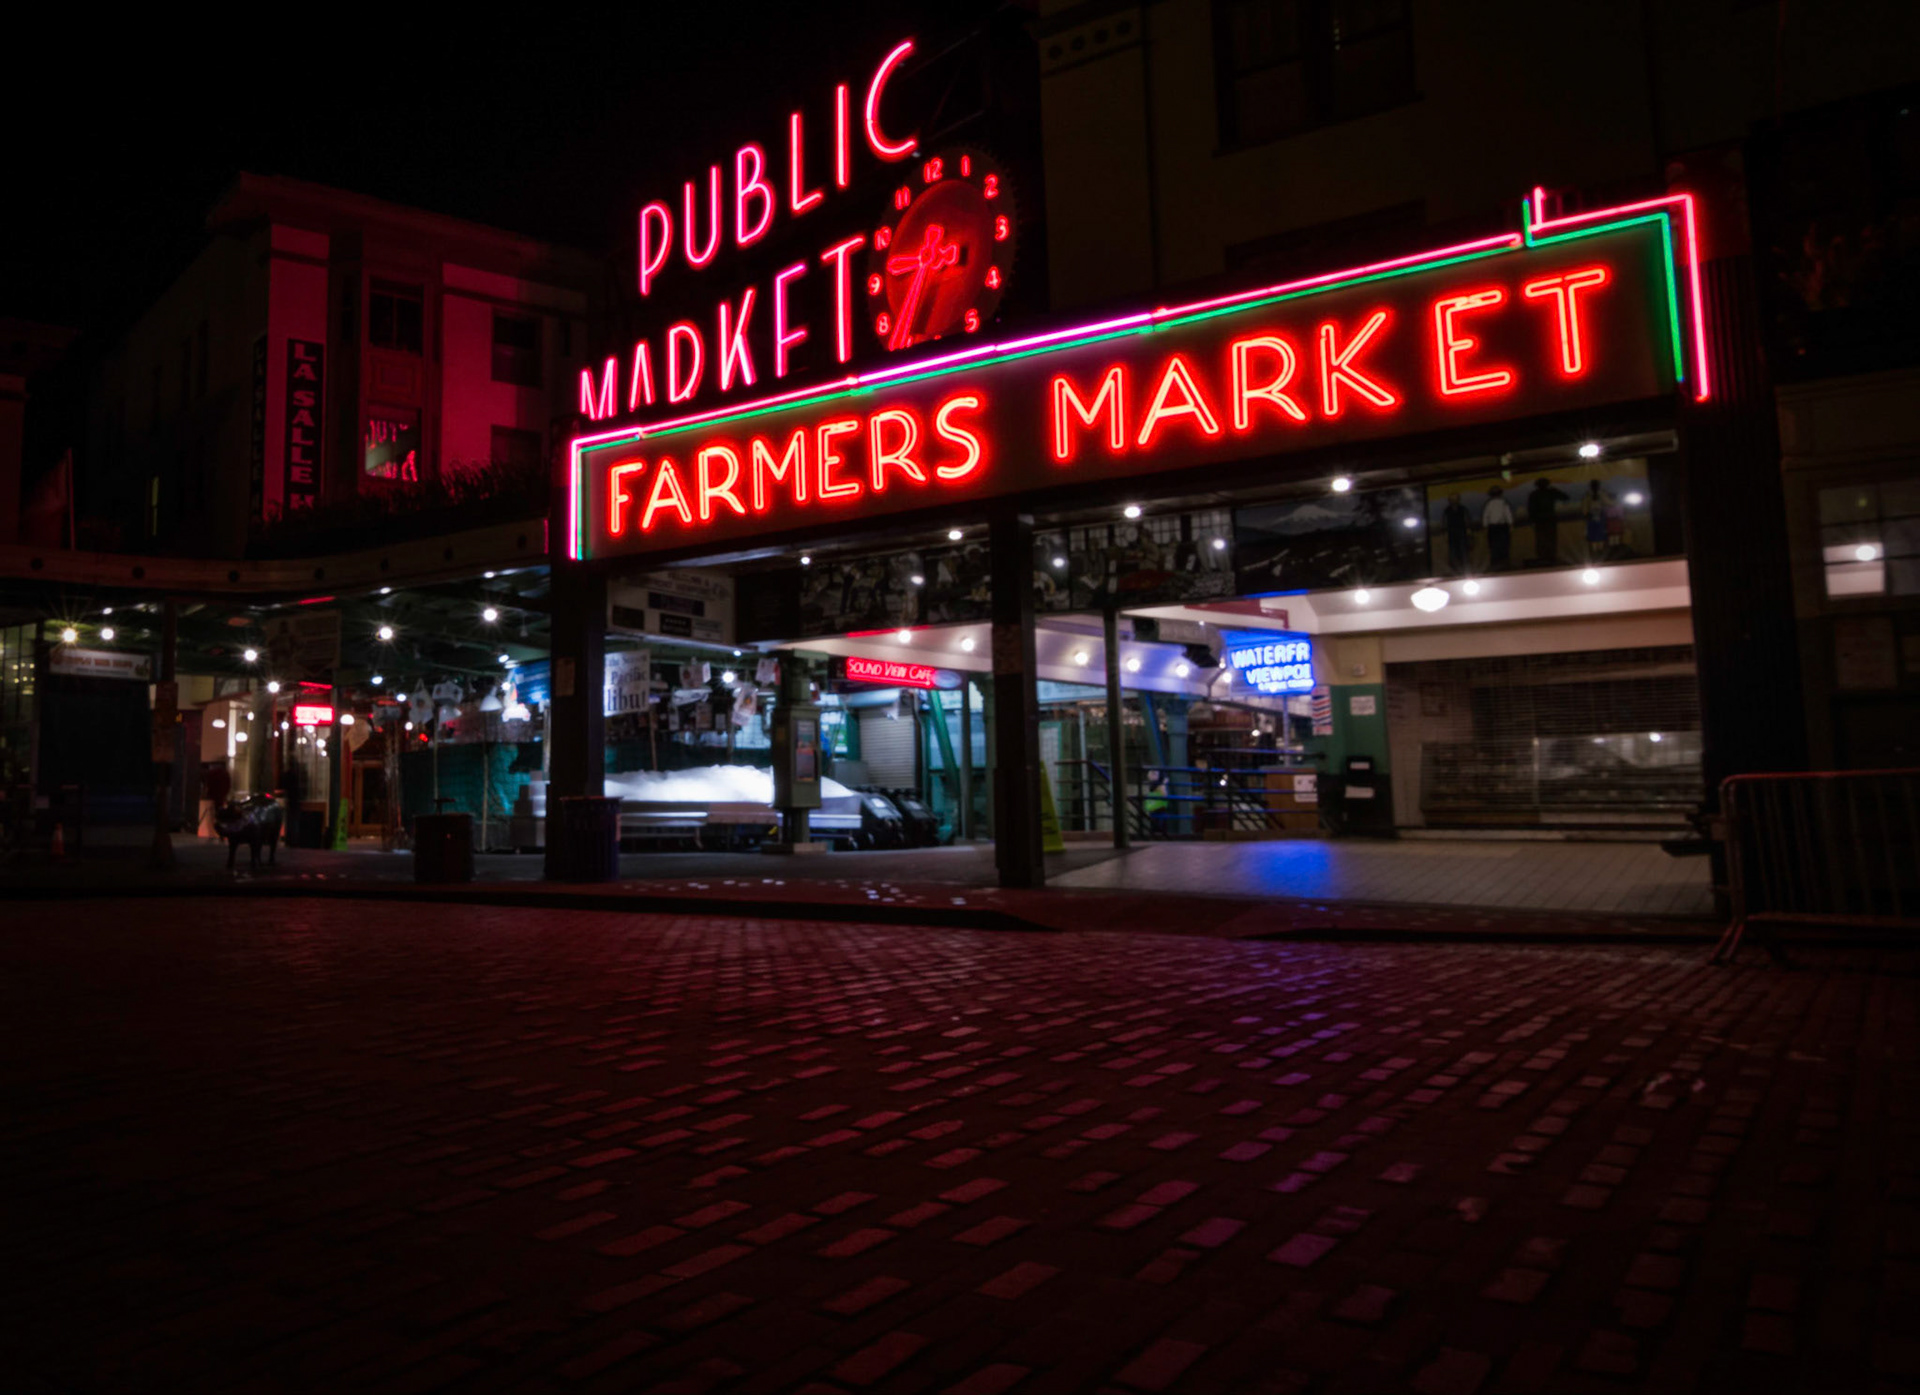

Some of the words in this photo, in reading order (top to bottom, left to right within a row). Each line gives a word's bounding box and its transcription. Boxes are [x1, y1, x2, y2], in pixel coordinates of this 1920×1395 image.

[638, 39, 918, 297] PUBLIC
[924, 157, 943, 182] 12
[961, 155, 970, 177] 1
[895, 186, 910, 210] 11
[984, 174, 998, 199] 2
[874, 226, 892, 250] 10
[995, 215, 1009, 241] 3
[868, 273, 883, 295] 9
[985, 266, 1000, 289] 4
[876, 312, 890, 335] 8
[965, 308, 979, 333] 5
[608, 394, 983, 536] FARMERS
[1051, 267, 1607, 460] MARKET
[848, 658, 882, 675] SOUND
[884, 661, 908, 678] VIEW
